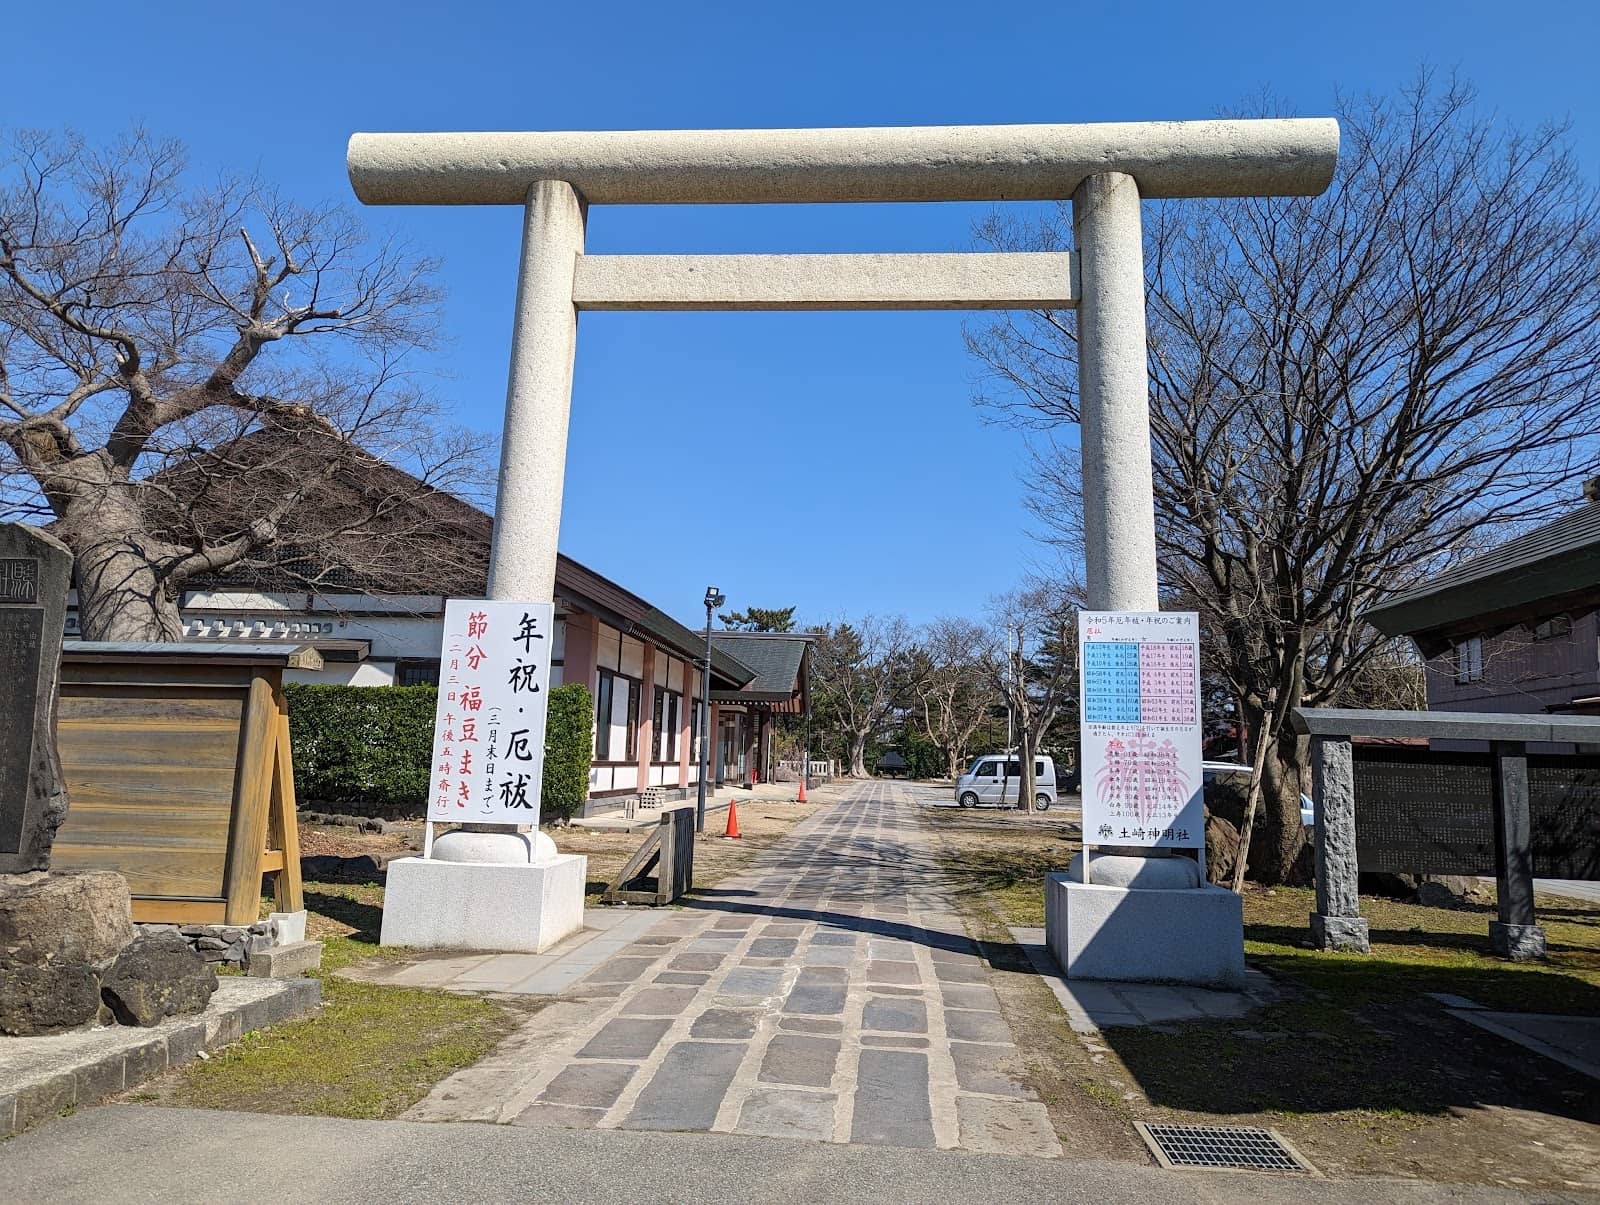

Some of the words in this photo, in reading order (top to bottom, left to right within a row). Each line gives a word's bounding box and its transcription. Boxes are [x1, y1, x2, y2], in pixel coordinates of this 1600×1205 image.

[465, 611, 488, 671] 節分
[457, 685, 484, 808] 福豆まき
[1119, 826, 1190, 840] 土崎神明社
